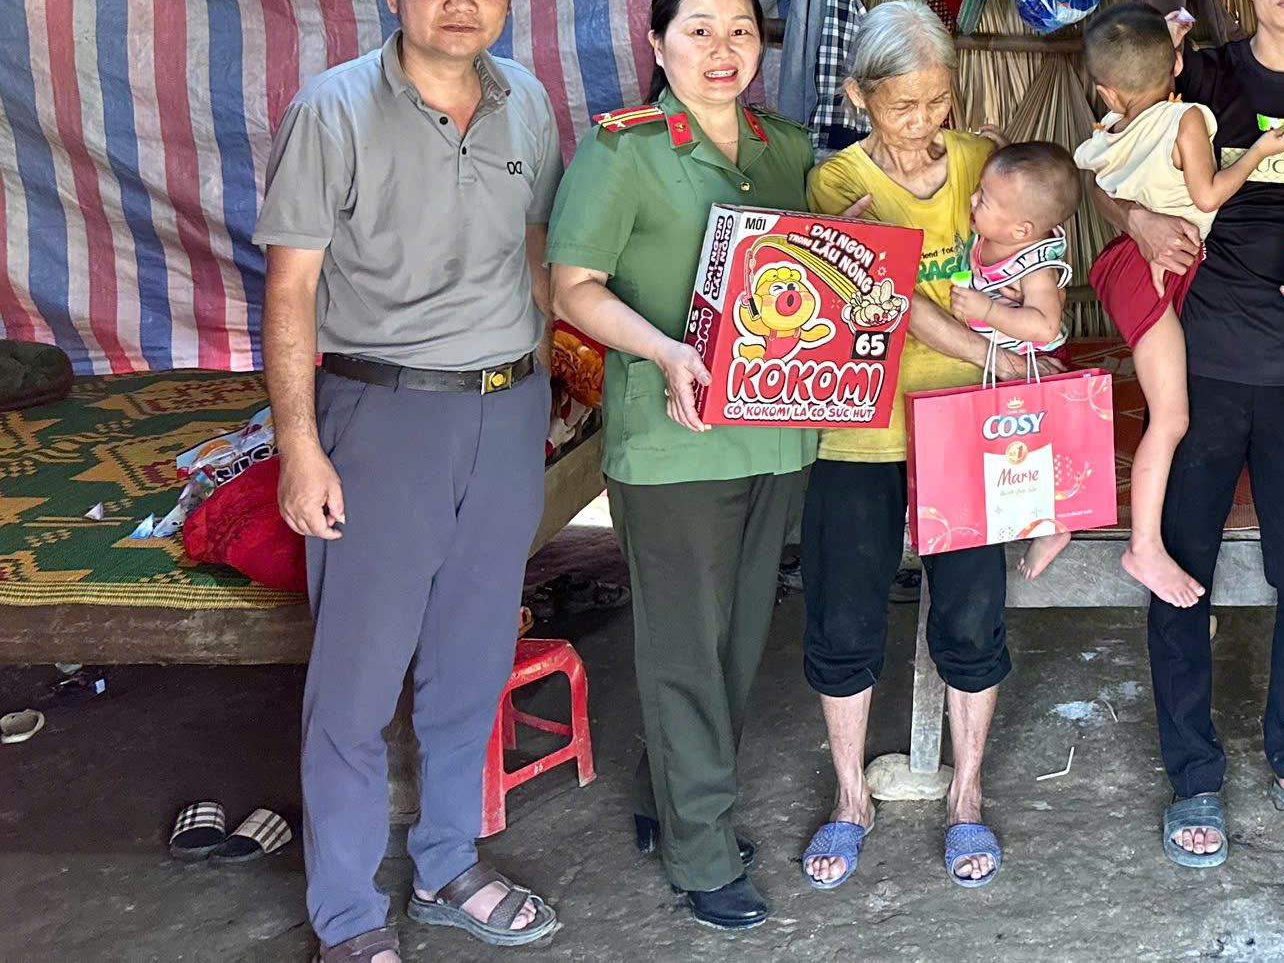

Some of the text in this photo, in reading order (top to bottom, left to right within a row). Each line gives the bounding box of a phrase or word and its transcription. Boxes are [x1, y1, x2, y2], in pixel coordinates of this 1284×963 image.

[745, 217, 766, 231] MỚI
[711, 217, 723, 263] NGON
[788, 233, 813, 247] TRONG
[836, 234, 875, 268] NGON
[838, 255, 874, 294] NÓNG
[689, 307, 700, 333] 65
[855, 333, 885, 357] 65
[728, 358, 884, 405] KOKOMI
[727, 403, 742, 415] CÓ
[746, 405, 790, 417] KOKOMI
[811, 405, 825, 418] CÓ
[828, 405, 850, 418] SỨC
[853, 406, 873, 419] HÚT
[982, 410, 1048, 441] COSY
[997, 468, 1039, 487] Marie
